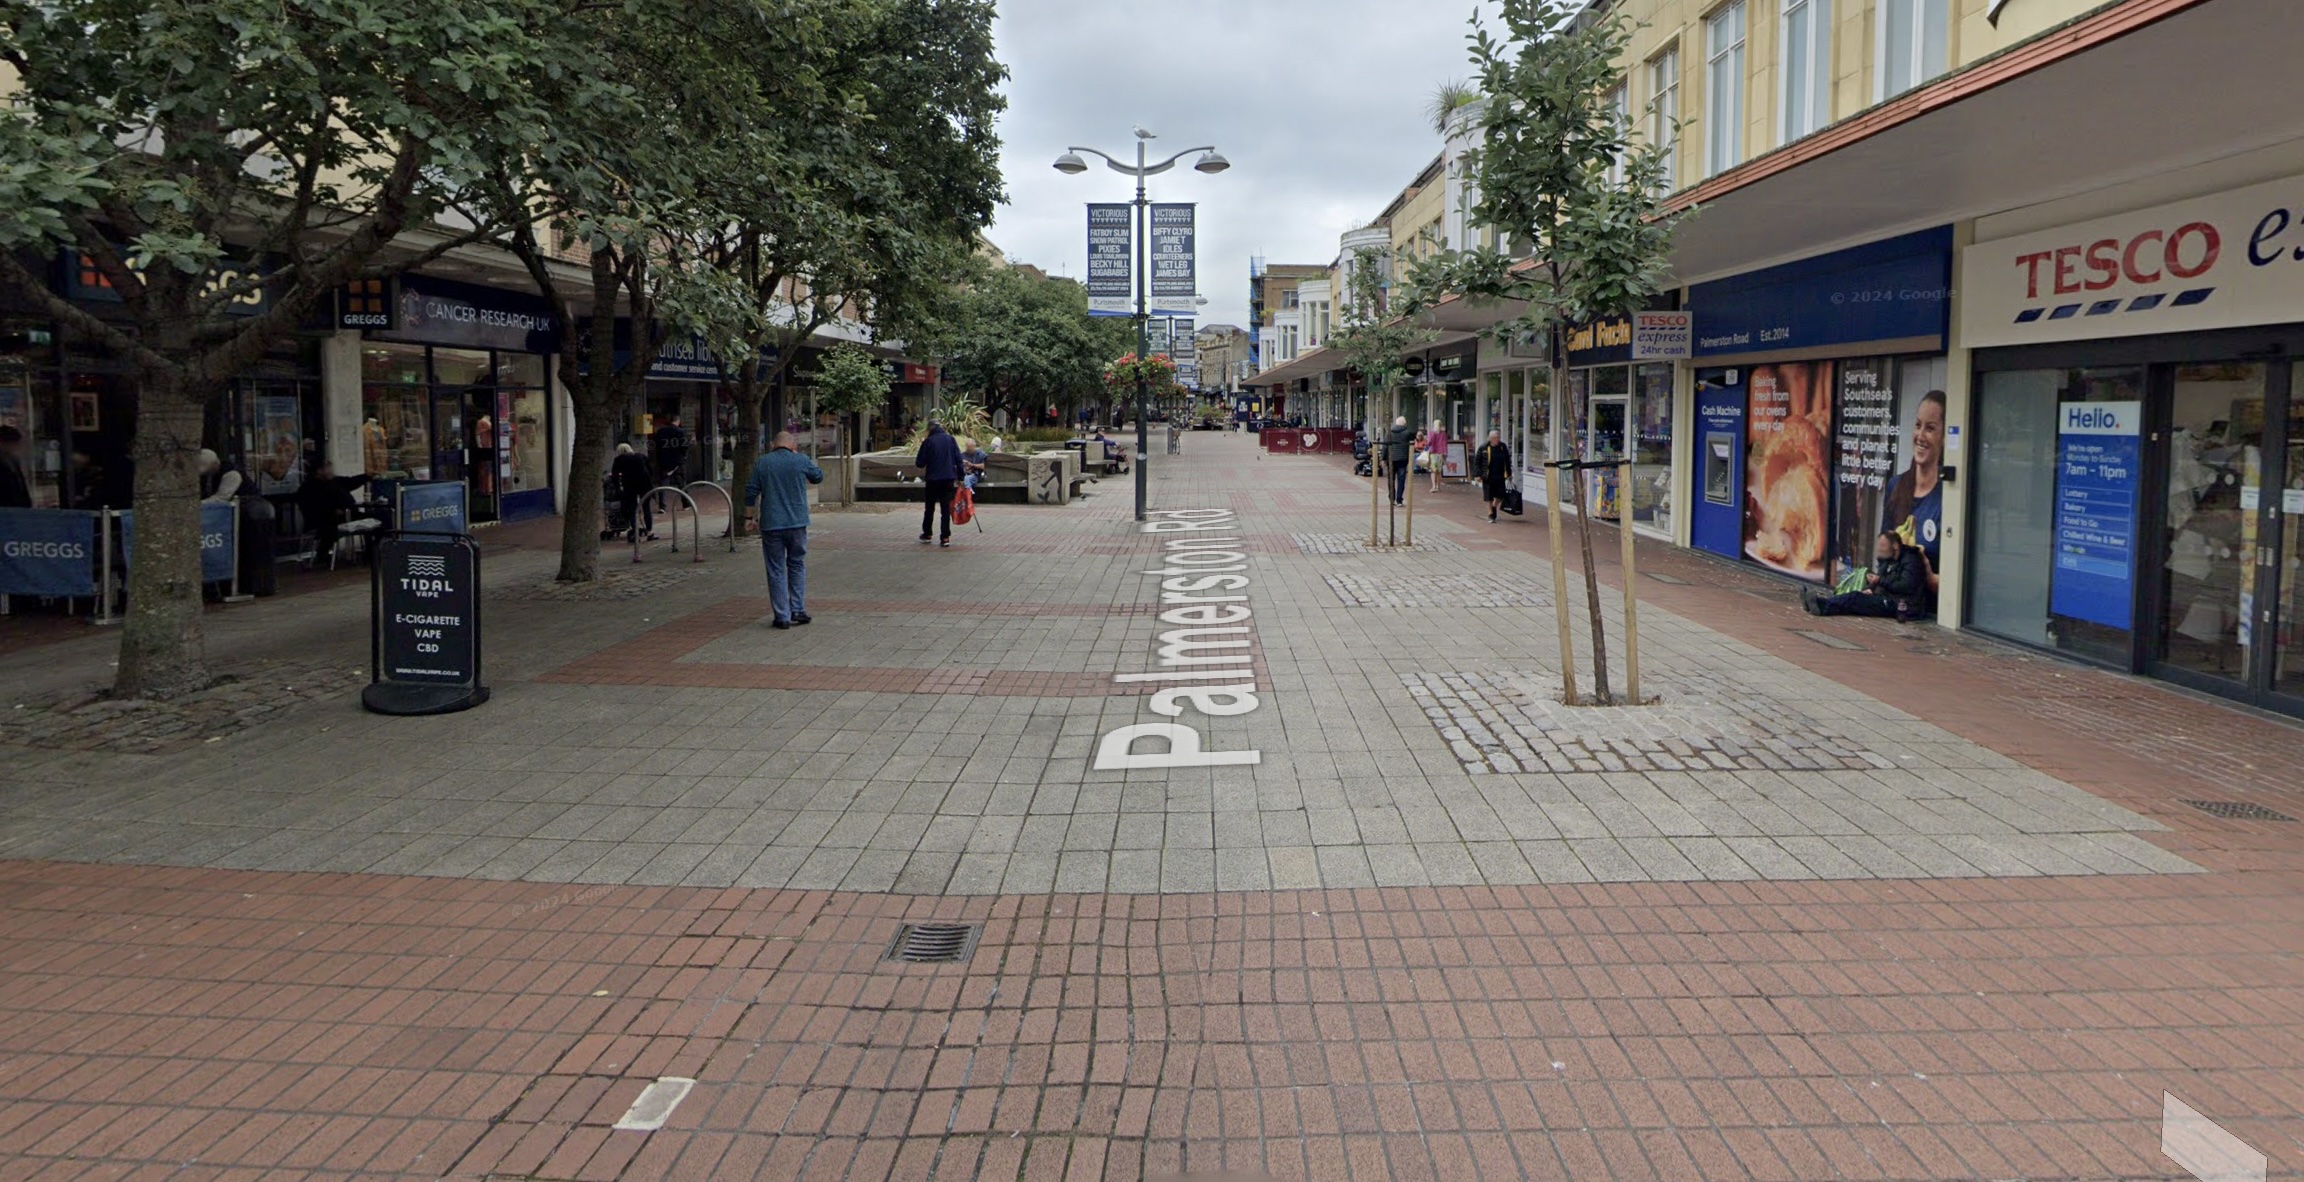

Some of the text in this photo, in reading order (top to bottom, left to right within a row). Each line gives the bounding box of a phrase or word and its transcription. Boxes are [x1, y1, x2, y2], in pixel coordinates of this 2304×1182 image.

[1091, 209, 1128, 217] VICTORIOUS
[1154, 209, 1191, 217] VICTORIOUS
[1090, 229, 1129, 237] FATBOY SLIM
[1153, 227, 1193, 236] BIFFY CLYRO
[1160, 236, 1186, 244] JAMIE T
[1098, 245, 1121, 253] PIXIES
[1163, 245, 1183, 253] IDLES
[1090, 260, 1129, 268] BECKY HILL
[2015, 222, 2221, 299] TESCO
[1155, 269, 1191, 277] JAMES BAY
[343, 314, 388, 325] GREGGS
[426, 302, 550, 332] CANCER RESEARCH UK
[1638, 315, 1688, 326] TESCO
[1596, 318, 1631, 348] Facto
[1638, 332, 1688, 345] express
[1760, 327, 1790, 342] Est.2014
[1700, 332, 1750, 348] Palmerston Road
[1640, 345, 1686, 355] 24hr cash
[651, 361, 663, 371] and
[664, 363, 688, 373] customer
[688, 362, 706, 374] service
[1754, 376, 1776, 389] Baking
[1844, 371, 1877, 387] Serving
[1754, 391, 1789, 402] fresh from
[1844, 388, 1893, 401] Southsea's
[1702, 405, 1741, 417] Cash Machine
[1753, 407, 1787, 417] our ovens
[1843, 405, 1892, 419] customers,
[2068, 408, 2120, 429] Hello.
[1753, 420, 1785, 433] every day
[1842, 422, 1900, 436] communities
[1841, 437, 1897, 455] and planet a
[2086, 445, 2103, 454] open
[1841, 453, 1893, 471] little better
[2098, 455, 2122, 465] Sunday
[2065, 462, 2087, 475] 7am
[2098, 464, 2127, 481] 11pm
[1840, 472, 1884, 490] every day
[2064, 488, 2089, 500] Lottery
[422, 504, 458, 519] GREGGS
[2064, 502, 2086, 513] Bakery
[2063, 516, 2099, 528] Food to Go
[2063, 530, 2085, 540] Chilled
[2085, 533, 2102, 543] Wine
[2109, 536, 2126, 546] Beer
[4, 541, 84, 559] GREGGS
[400, 578, 454, 592] TIDAL
[395, 613, 460, 626] E-CIGARETTE
[414, 628, 442, 639] VAPE
[416, 643, 439, 653] CBD
